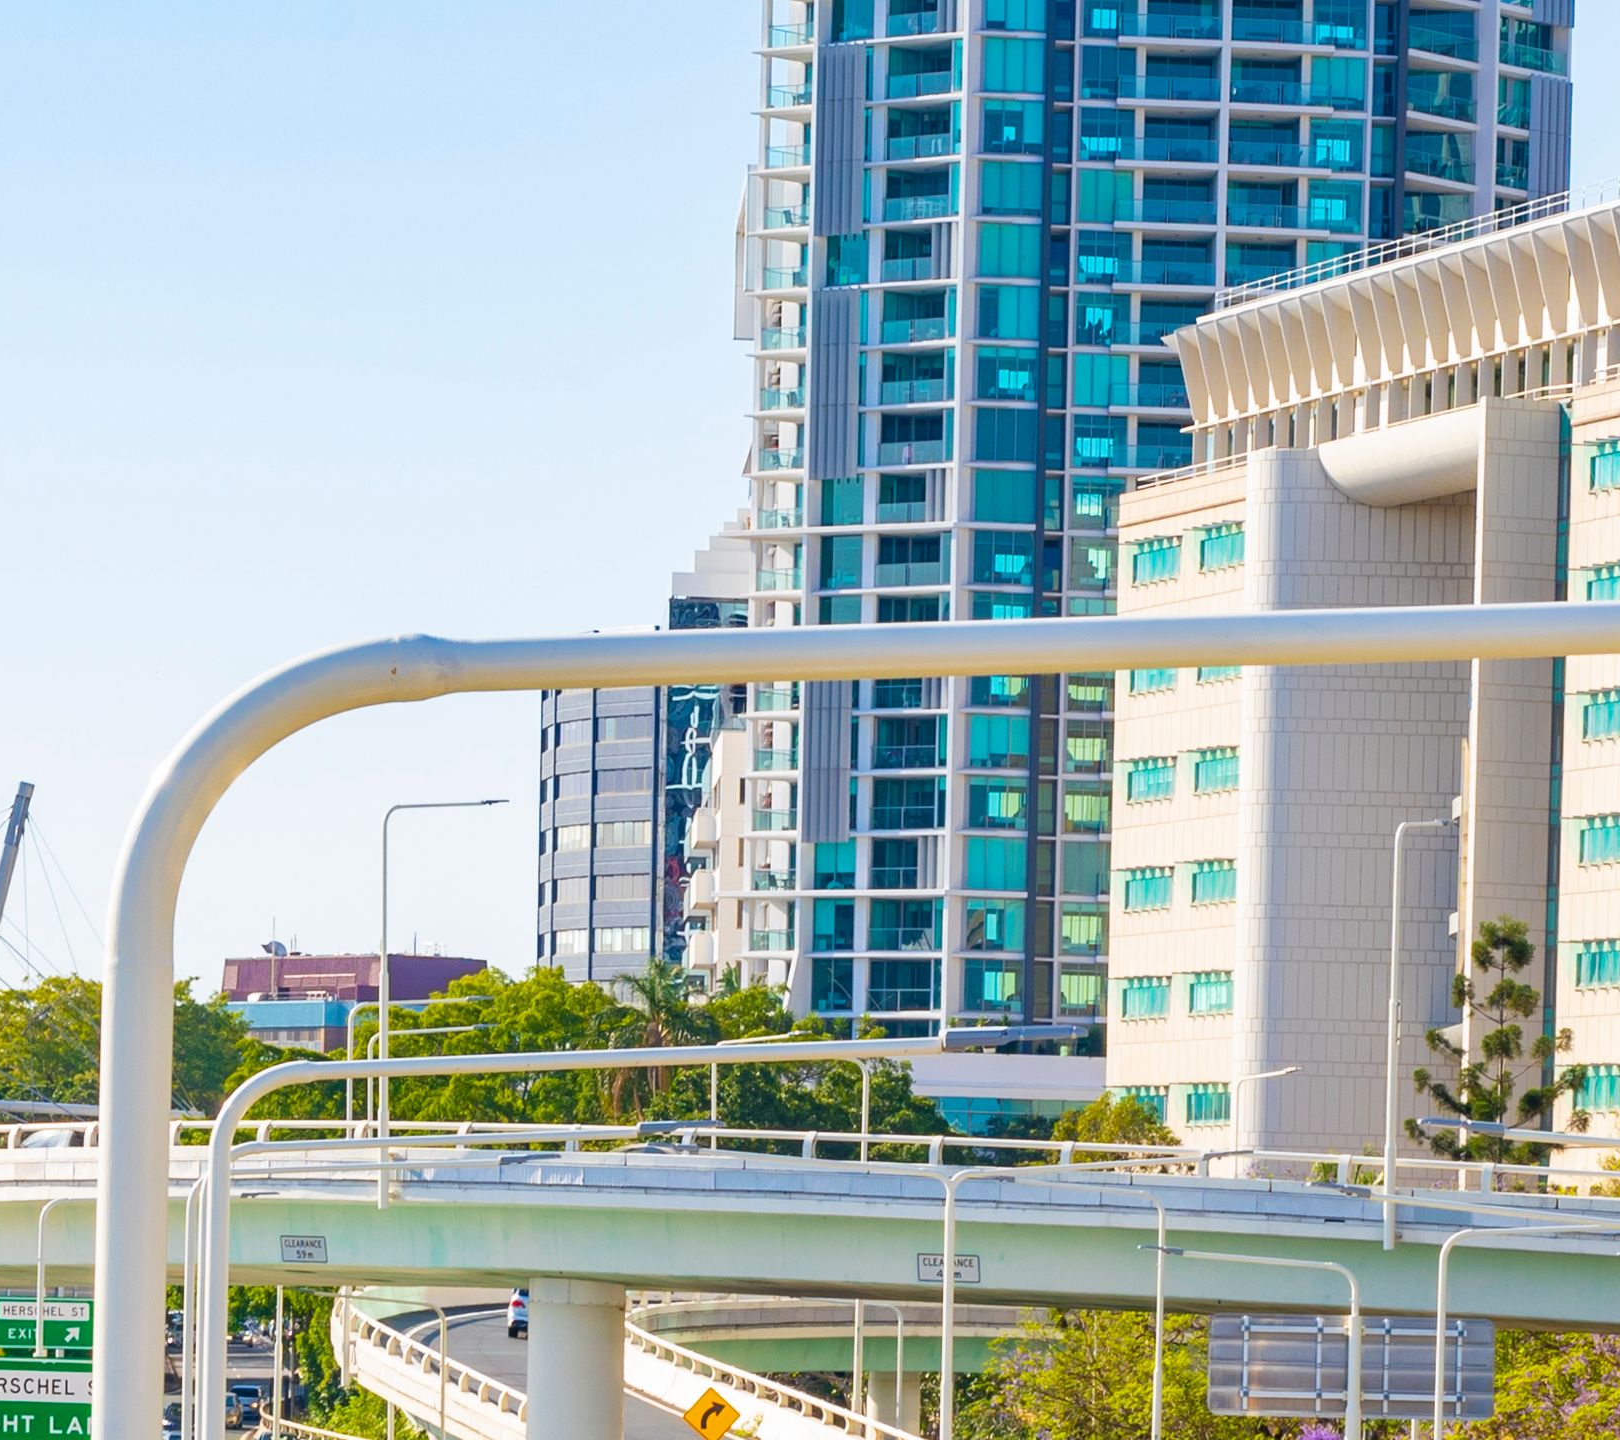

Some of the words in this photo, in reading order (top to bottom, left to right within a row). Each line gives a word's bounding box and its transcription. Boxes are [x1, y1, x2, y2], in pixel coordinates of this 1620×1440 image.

[284, 1239, 322, 1248] CLEARANCE
[923, 1257, 975, 1268] CLEAANCE
[71, 1306, 86, 1317] ST
[8, 1328, 37, 1339] EXI
